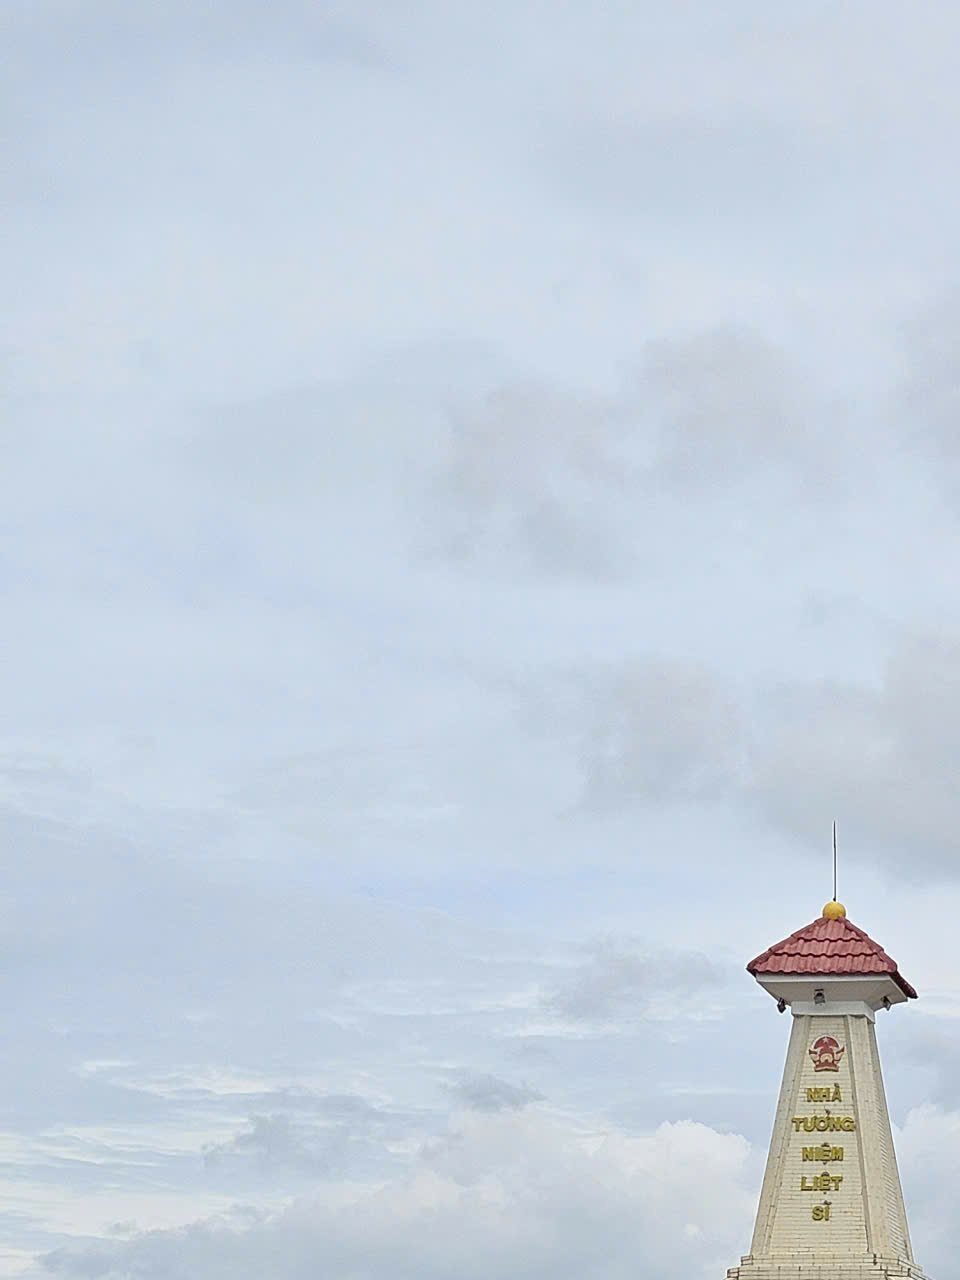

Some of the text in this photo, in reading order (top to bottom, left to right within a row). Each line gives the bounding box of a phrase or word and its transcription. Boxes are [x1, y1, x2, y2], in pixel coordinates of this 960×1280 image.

[806, 1083, 842, 1102] NHÀ
[792, 1108, 856, 1132] TƯỞNG
[801, 1142, 844, 1165] NIỆM
[800, 1171, 843, 1194] LIỆT
[811, 1200, 832, 1221] SĨ
